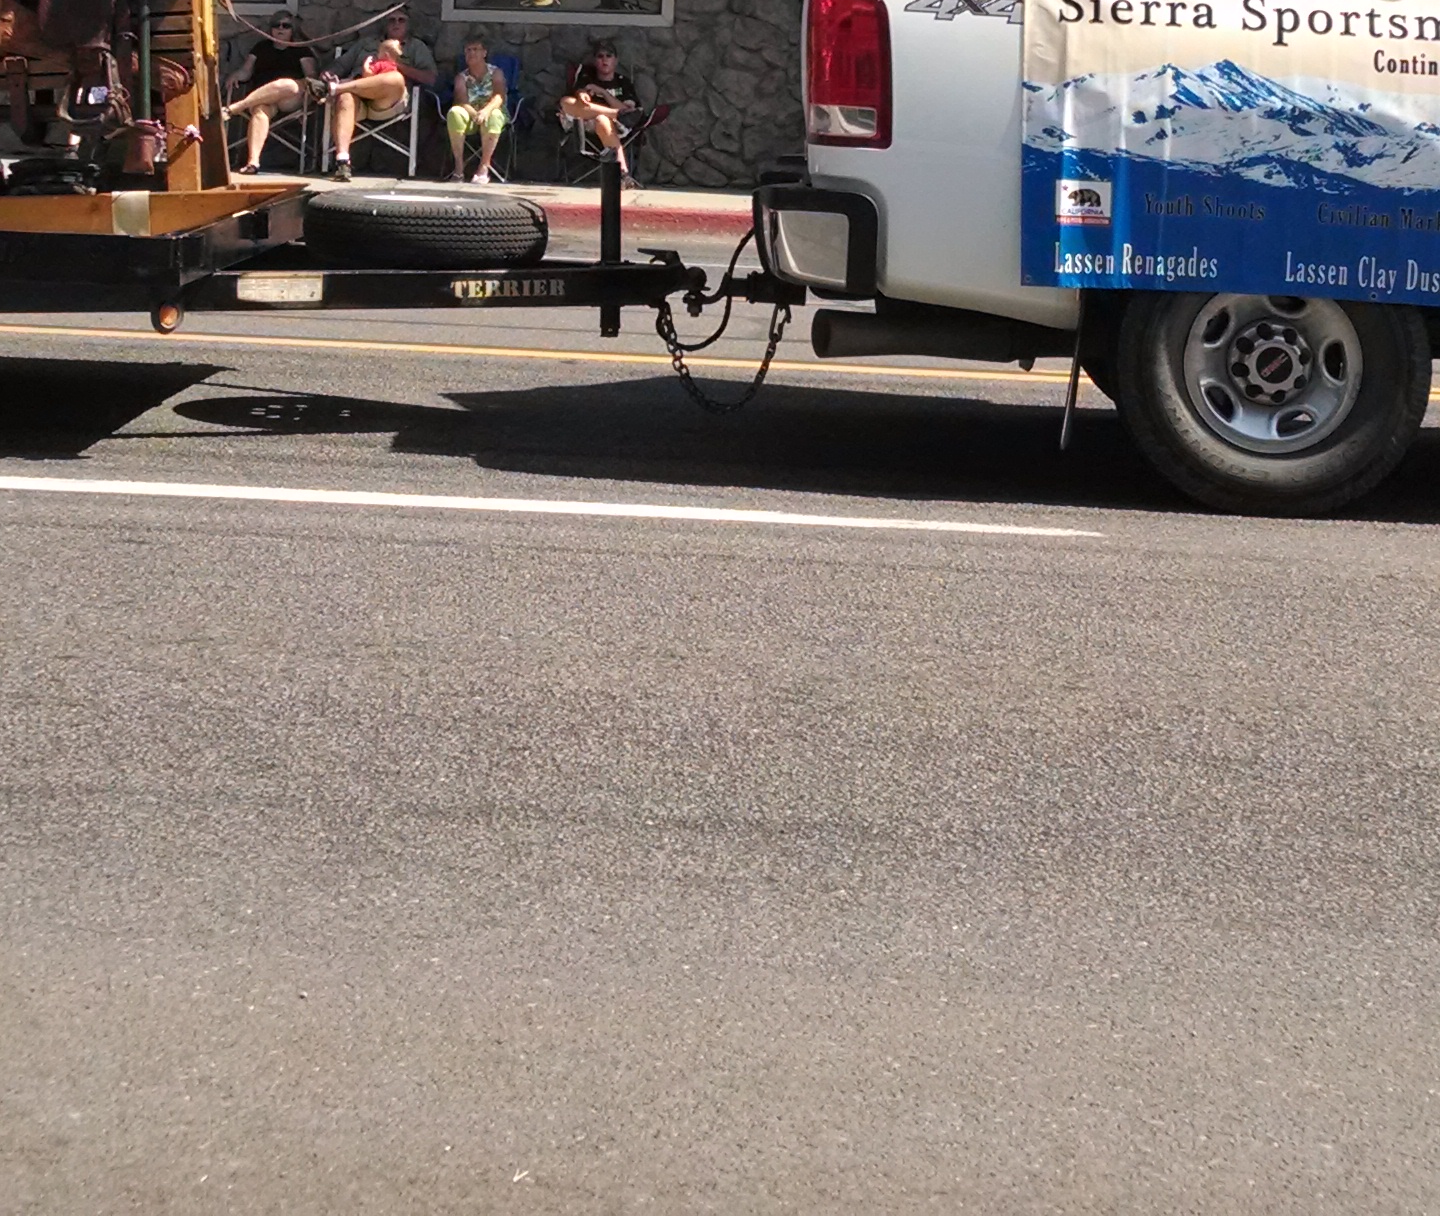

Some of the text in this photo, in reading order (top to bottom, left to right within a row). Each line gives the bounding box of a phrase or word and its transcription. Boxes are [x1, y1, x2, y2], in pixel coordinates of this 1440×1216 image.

[1145, 193, 1193, 216] Youth
[1202, 196, 1266, 220] Shoots
[1318, 203, 1389, 228] Civilian
[1054, 241, 1218, 282] Lassen Renagades
[1285, 251, 1348, 286] Lassen
[1359, 256, 1396, 295] Clay
[450, 278, 566, 299] TERRIER
